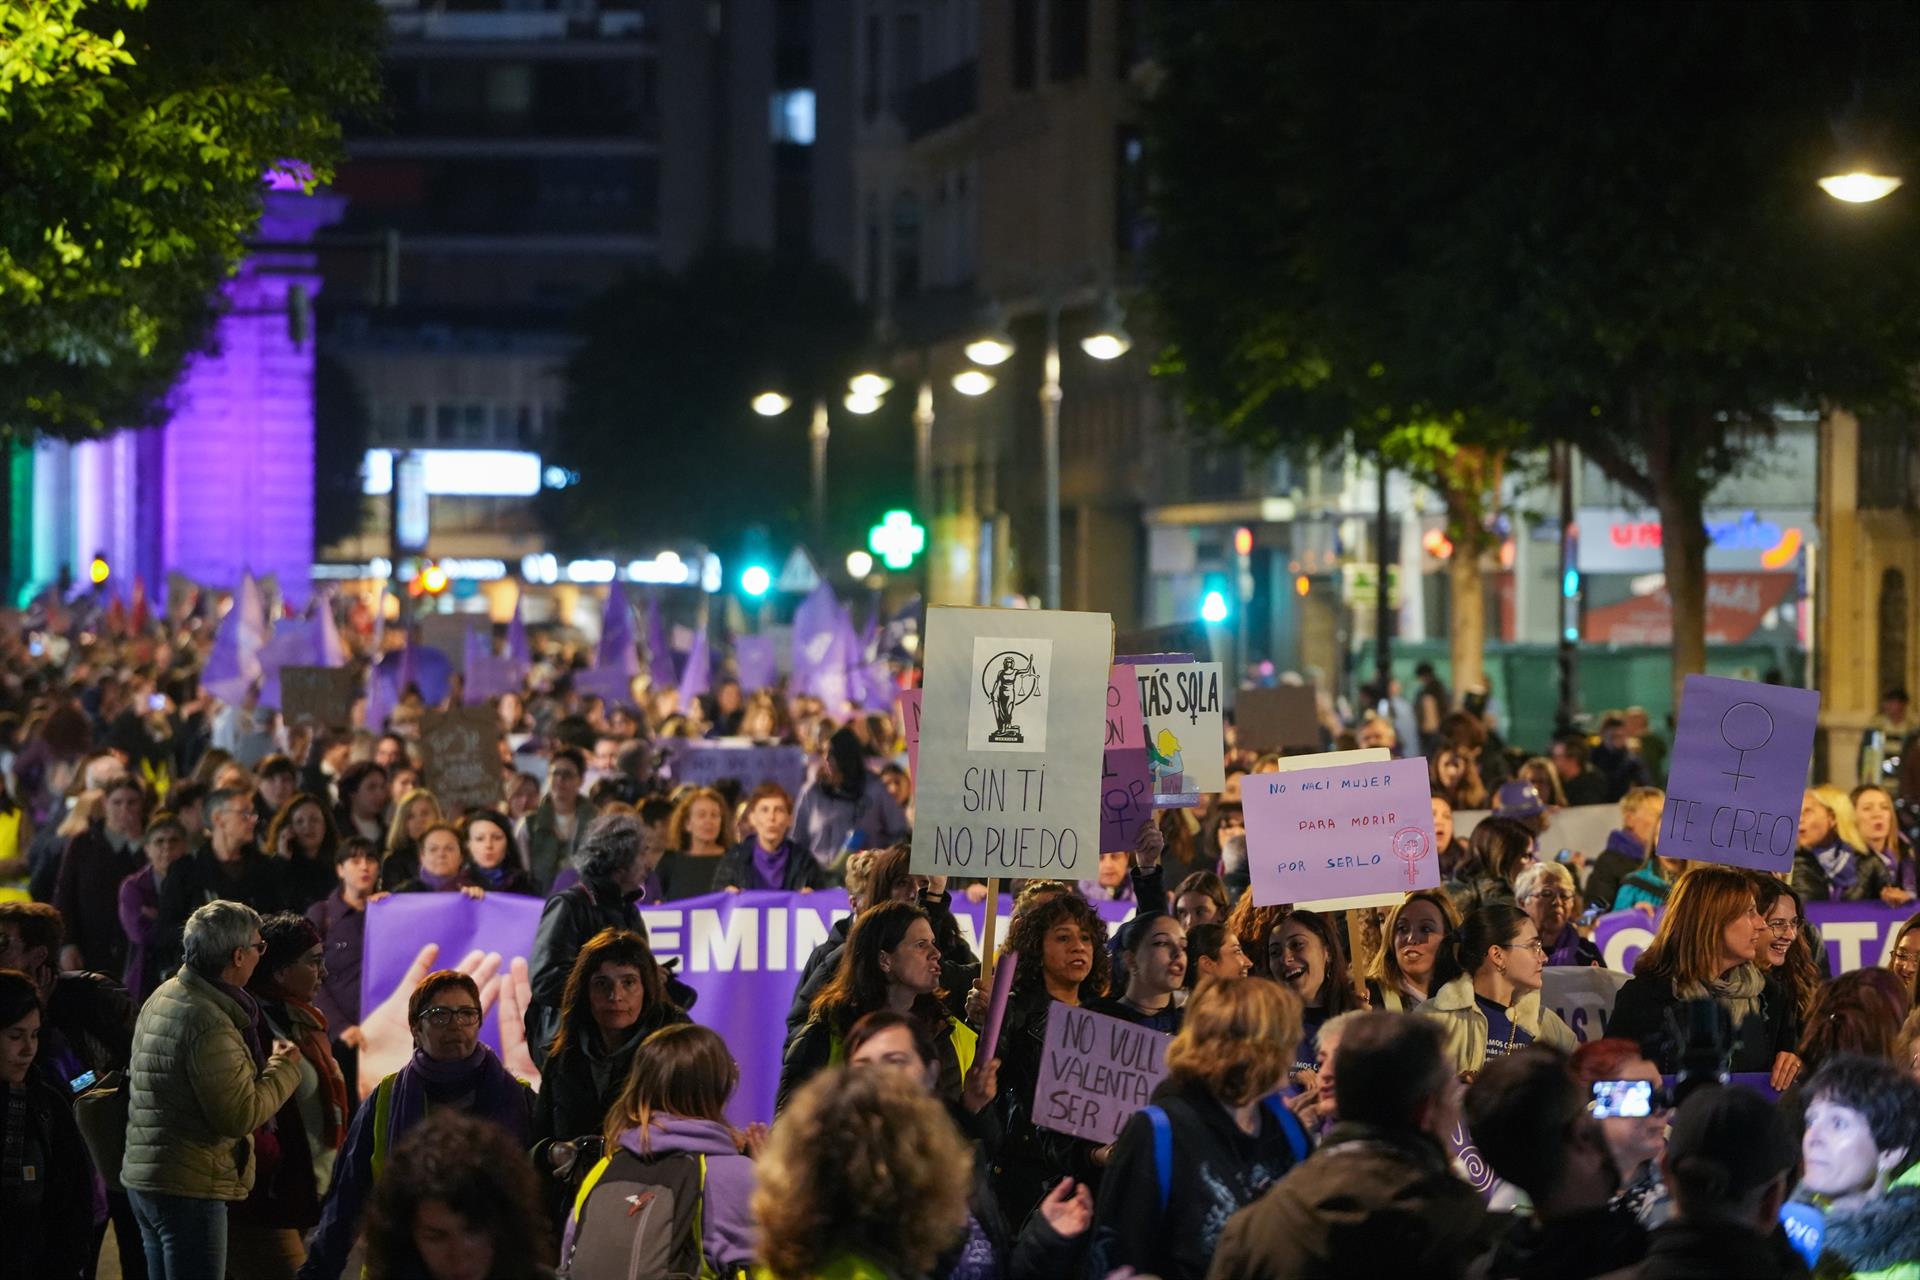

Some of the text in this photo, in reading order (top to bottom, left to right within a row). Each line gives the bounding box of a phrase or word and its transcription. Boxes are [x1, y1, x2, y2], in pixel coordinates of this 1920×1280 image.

[1138, 668, 1219, 725] TÁS SOLA
[963, 766, 1005, 812] SIN
[1269, 775, 1392, 795] NO NACI MUJER
[1298, 812, 1396, 830] PARA MORIR
[1668, 798, 1794, 857] TE CREO
[934, 826, 1078, 870] NO PUEDO
[1277, 854, 1381, 873] POR SERLO
[640, 906, 850, 973] EMIN
[1062, 1010, 1159, 1075] NO VULL
[1051, 1050, 1149, 1105] VALENTA
[1048, 1090, 1100, 1129] SER
